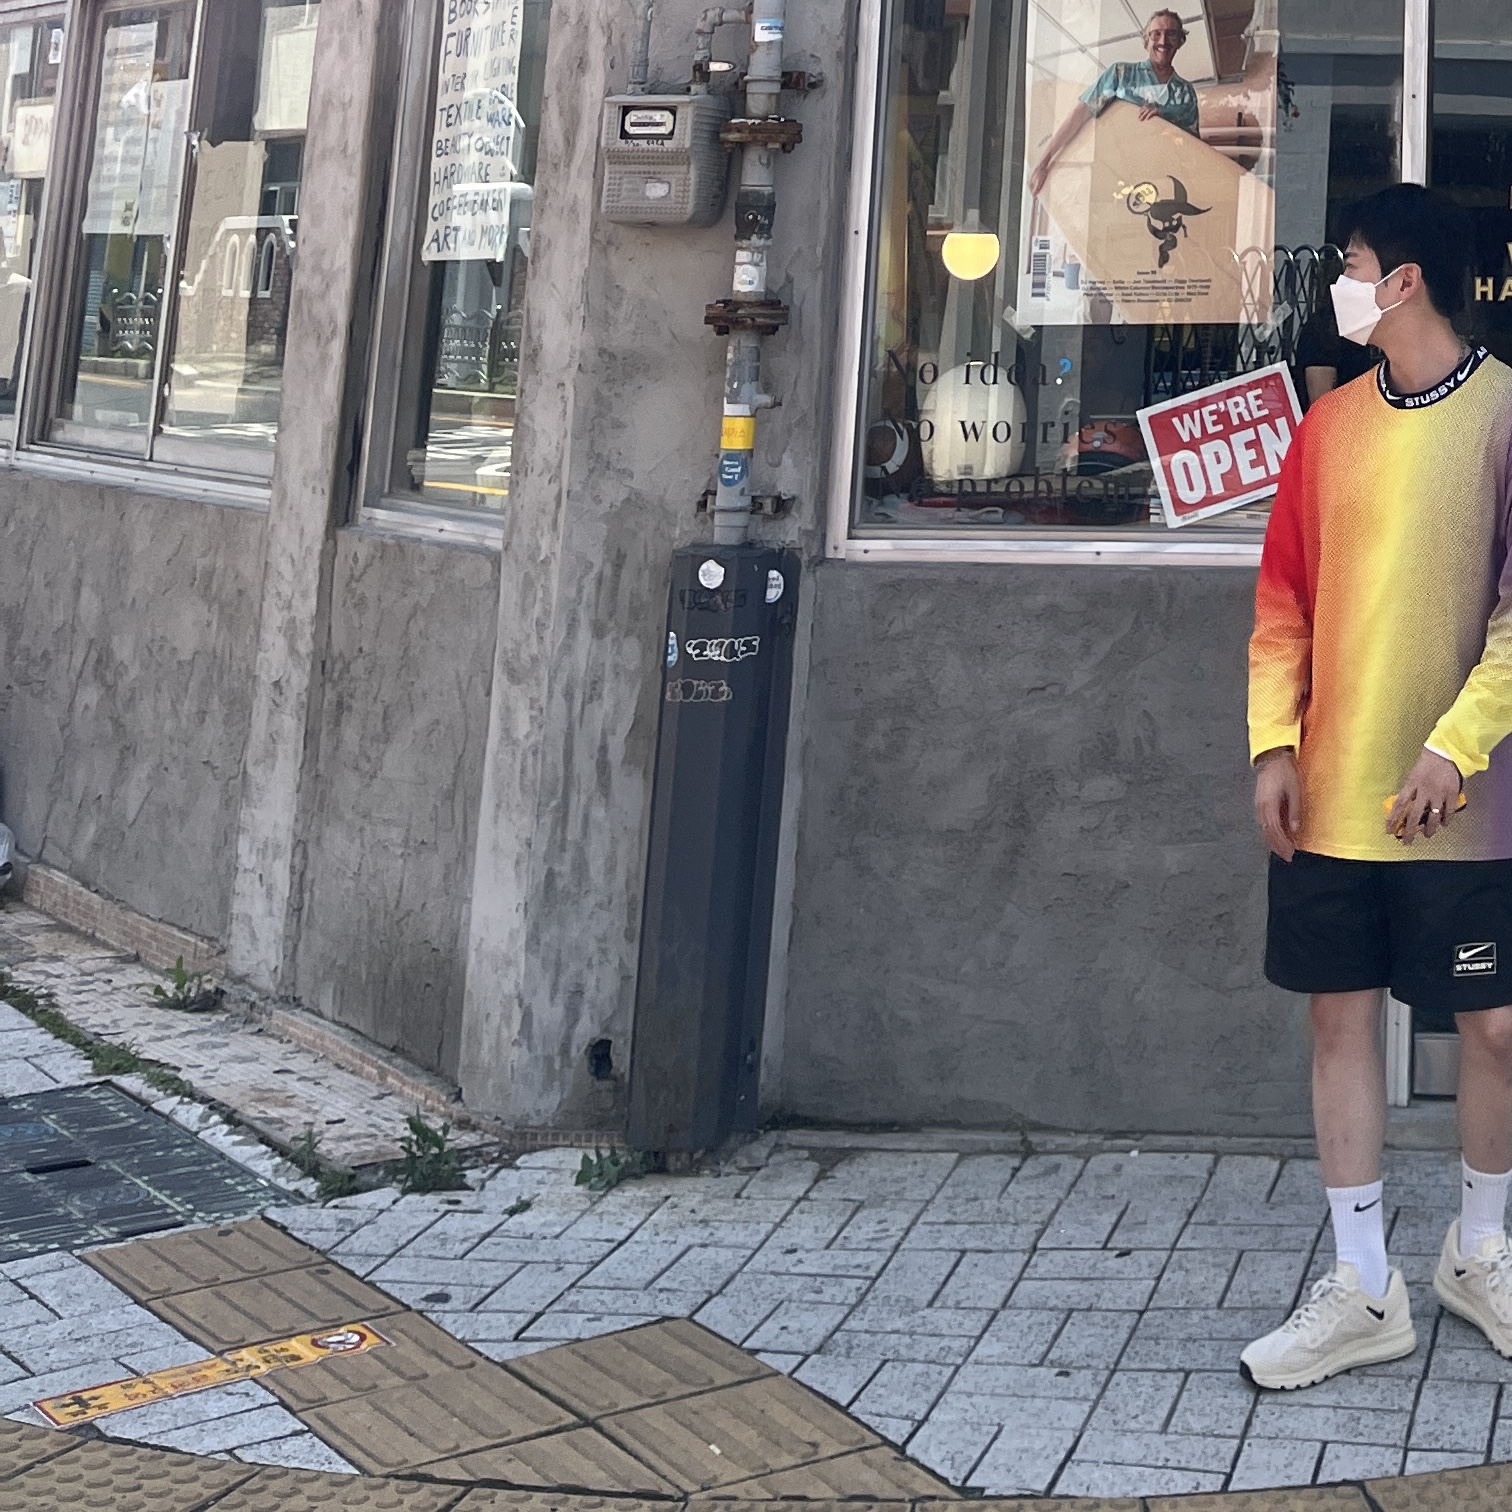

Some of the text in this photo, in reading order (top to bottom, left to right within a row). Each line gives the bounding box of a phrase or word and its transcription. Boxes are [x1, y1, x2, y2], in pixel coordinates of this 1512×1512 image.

[439, 99, 482, 132] TEXTILE
[436, 131, 474, 158] BEAUTY
[433, 161, 491, 196] HARDWARE
[431, 191, 469, 222] COFFEE
[426, 225, 461, 253] ART
[1405, 377, 1455, 407] STUSSY
[958, 409, 1118, 444] worries
[1170, 416, 1293, 505] OPEN
